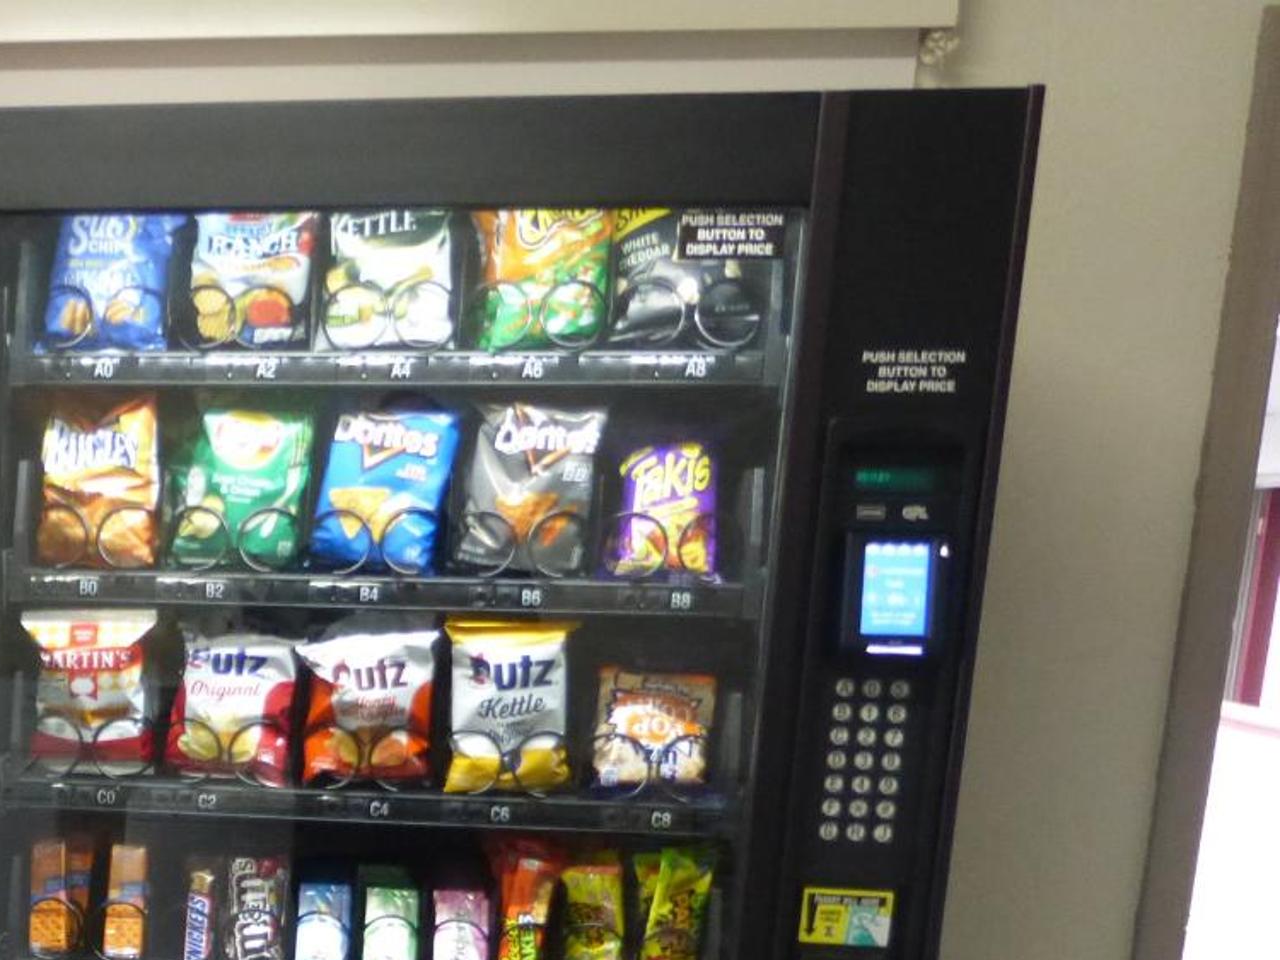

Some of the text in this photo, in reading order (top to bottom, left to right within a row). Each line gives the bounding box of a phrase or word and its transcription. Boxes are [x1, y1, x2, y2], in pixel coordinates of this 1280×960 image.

[332, 210, 417, 237] KETTLE
[682, 214, 783, 227] PUSH SELECTION
[697, 228, 765, 241] BUTTON TO
[686, 243, 773, 256] DISPLAY PRICE
[862, 351, 966, 364] PUSH SELECTION
[94, 363, 114, 378] A0
[256, 363, 276, 379] A2
[391, 364, 411, 379] A4
[522, 362, 544, 379] A6
[685, 363, 707, 378] A8
[877, 366, 947, 378] BUTTON TO
[866, 380, 956, 393] DISPLAY PRICE
[631, 450, 711, 503] Takis
[79, 580, 99, 595] B0
[206, 583, 225, 599] B2
[360, 586, 378, 601] B4
[521, 589, 541, 606] B6
[40, 649, 132, 670] MARTIN'S
[478, 694, 547, 719] Kettle
[97, 789, 116, 804] C0
[198, 793, 217, 808] C2
[370, 800, 389, 817] C4
[490, 805, 510, 821] C6
